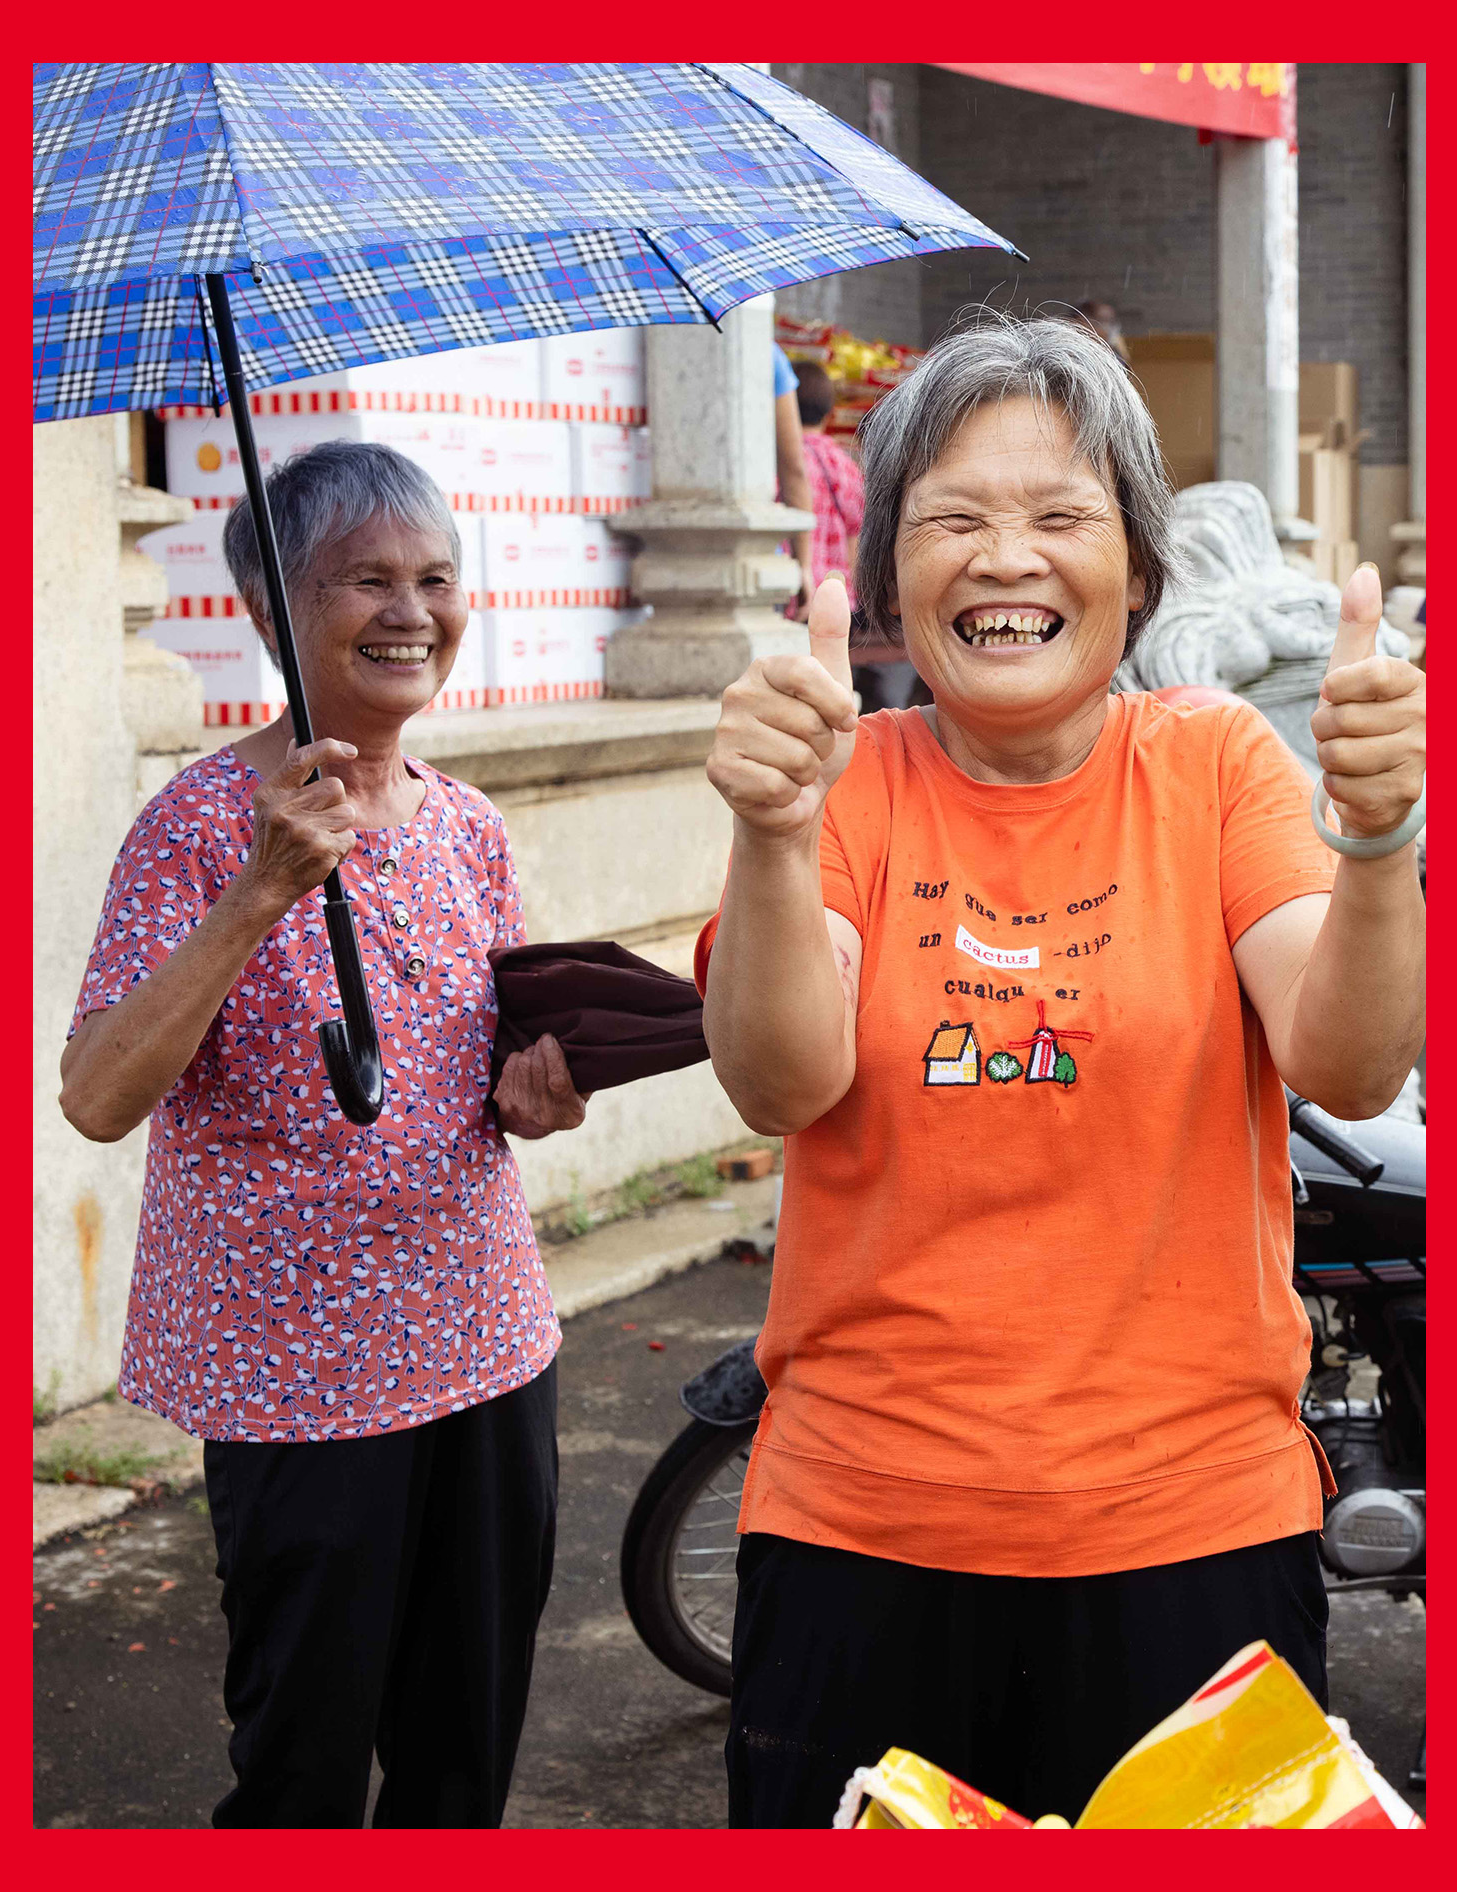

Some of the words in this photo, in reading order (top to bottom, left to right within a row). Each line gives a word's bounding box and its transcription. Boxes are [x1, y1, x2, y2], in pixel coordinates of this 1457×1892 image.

[912, 880, 949, 900] Hay
[1011, 911, 1049, 926] ser
[1066, 883, 1118, 915] como
[918, 932, 942, 948] un
[962, 938, 1029, 965] cactus
[944, 979, 1025, 1003] cualqu
[1055, 987, 1081, 1001] er
